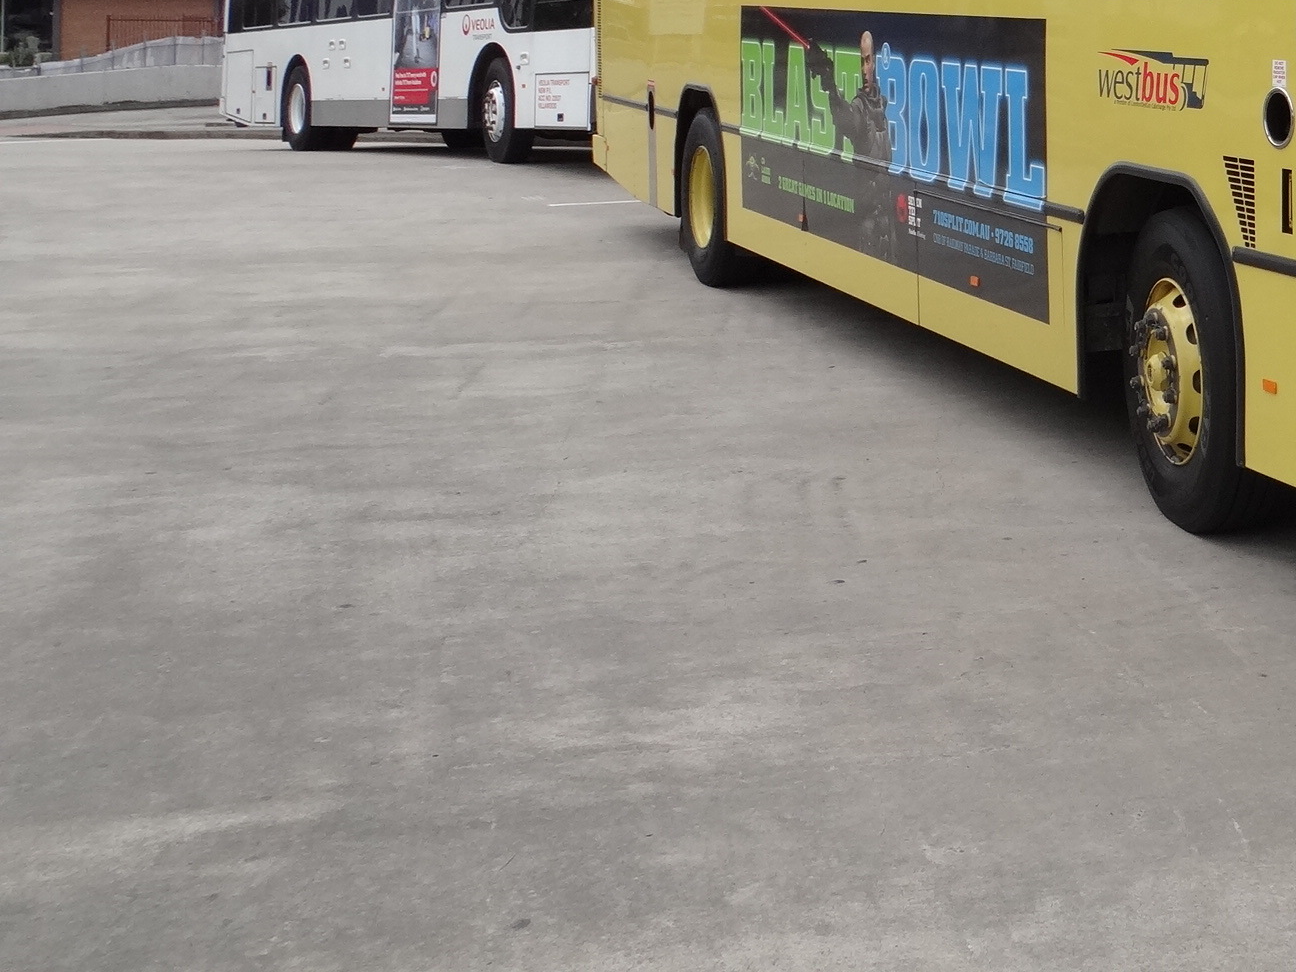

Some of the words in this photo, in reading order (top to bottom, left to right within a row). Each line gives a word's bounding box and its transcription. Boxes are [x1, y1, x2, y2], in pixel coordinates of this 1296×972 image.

[471, 18, 495, 31] VEOLIA
[1098, 61, 1180, 106] westbus
[739, 39, 863, 163] BLAST
[875, 53, 1047, 212] BOWL
[994, 227, 1014, 249] 9726
[1014, 232, 1034, 255] 8558
